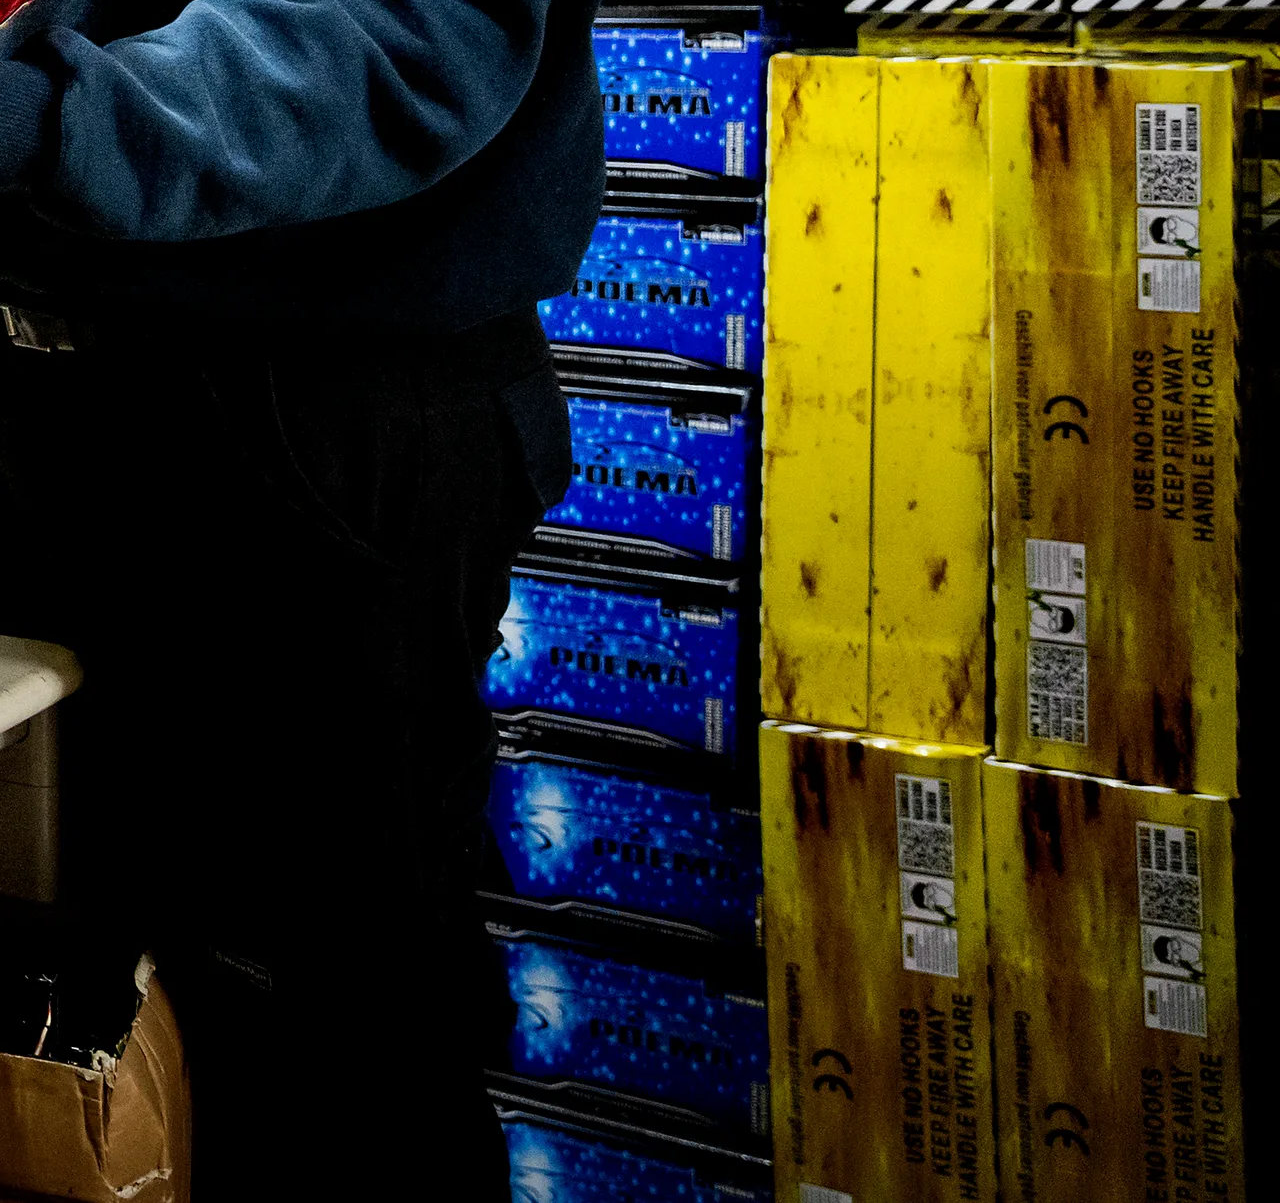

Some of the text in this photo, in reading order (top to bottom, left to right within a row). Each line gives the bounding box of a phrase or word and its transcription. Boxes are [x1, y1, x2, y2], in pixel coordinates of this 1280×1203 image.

[1132, 350, 1155, 511] USE NO HOOKS
[1162, 345, 1184, 520] KEEP FIRE AWAY
[1191, 329, 1214, 542] HANDLE WITH CARE
[900, 1008, 924, 1163] USE NO HOOKS
[926, 1005, 951, 1177] KEEP FIRE AWAY
[952, 994, 978, 1200] HANDLE WITH CARE
[1142, 1068, 1167, 1182] NO HOOKS
[1170, 1066, 1196, 1182] FIRE AWAY
[1200, 1053, 1226, 1174] WITH CARE
